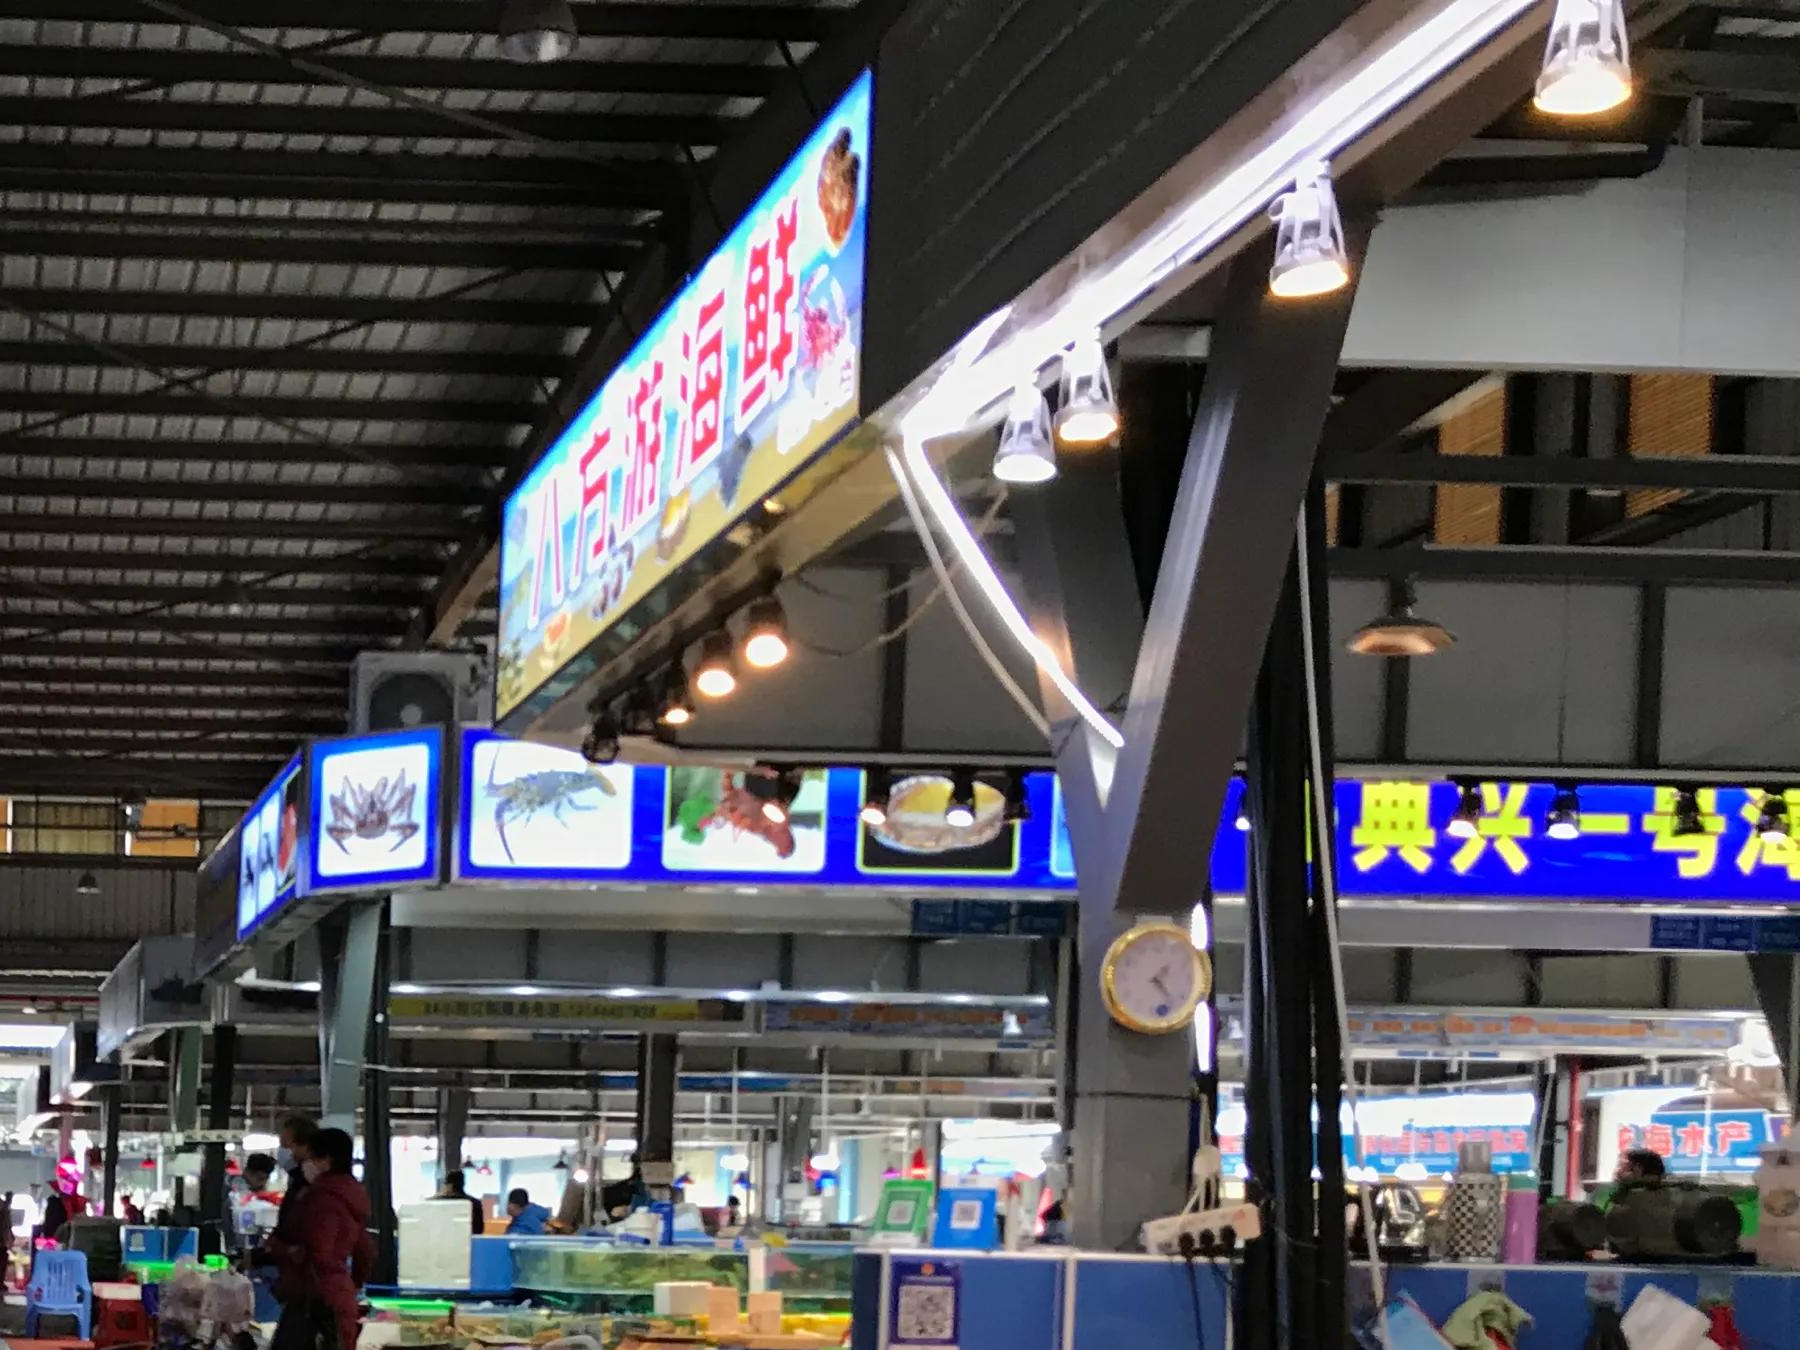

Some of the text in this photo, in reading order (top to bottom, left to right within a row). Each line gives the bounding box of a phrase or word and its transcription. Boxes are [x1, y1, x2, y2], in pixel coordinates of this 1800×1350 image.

[530, 197, 800, 618] 八方游海鲜
